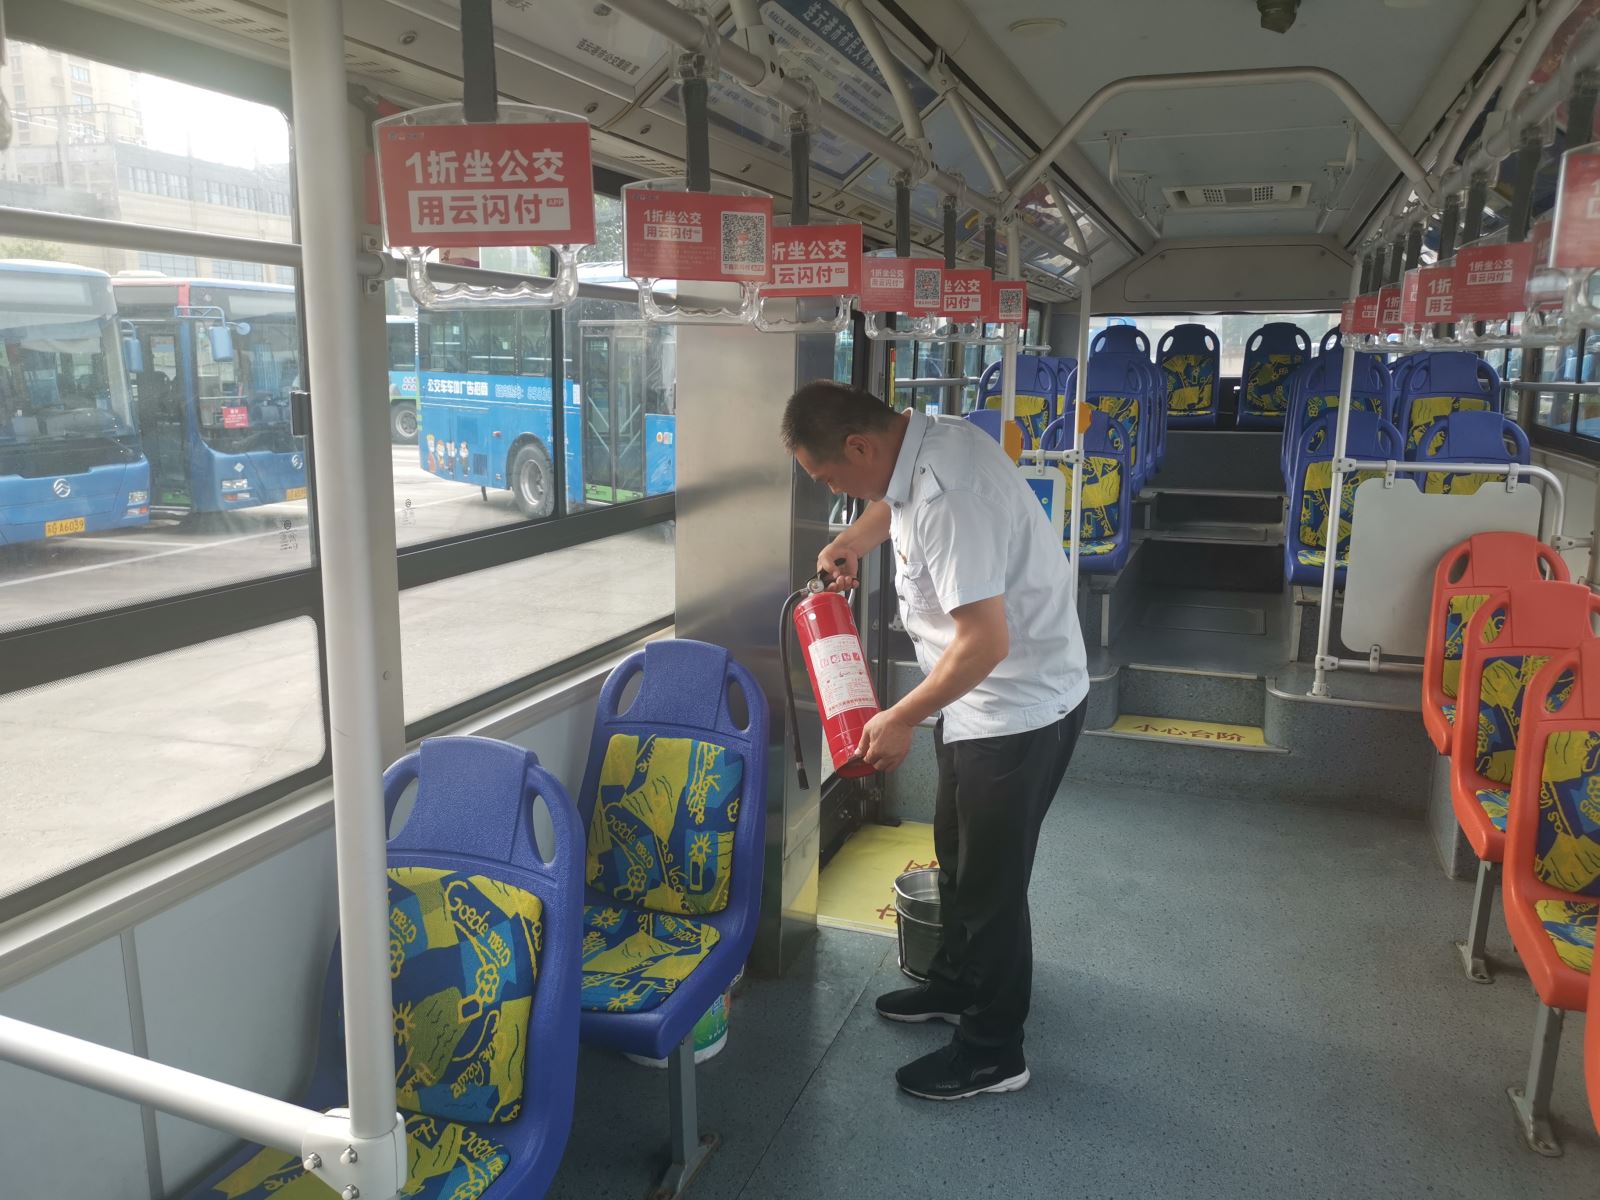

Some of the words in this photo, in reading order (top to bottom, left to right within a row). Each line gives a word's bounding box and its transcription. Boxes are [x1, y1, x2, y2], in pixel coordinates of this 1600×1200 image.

[404, 148, 566, 185] 1折坐公交
[417, 193, 543, 227] 用云闪付
[643, 209, 702, 225] 1折坐公交
[646, 225, 693, 240] 用云闪付
[1467, 258, 1513, 272] 1折坐公交
[1133, 723, 1246, 743] 小心台阶
